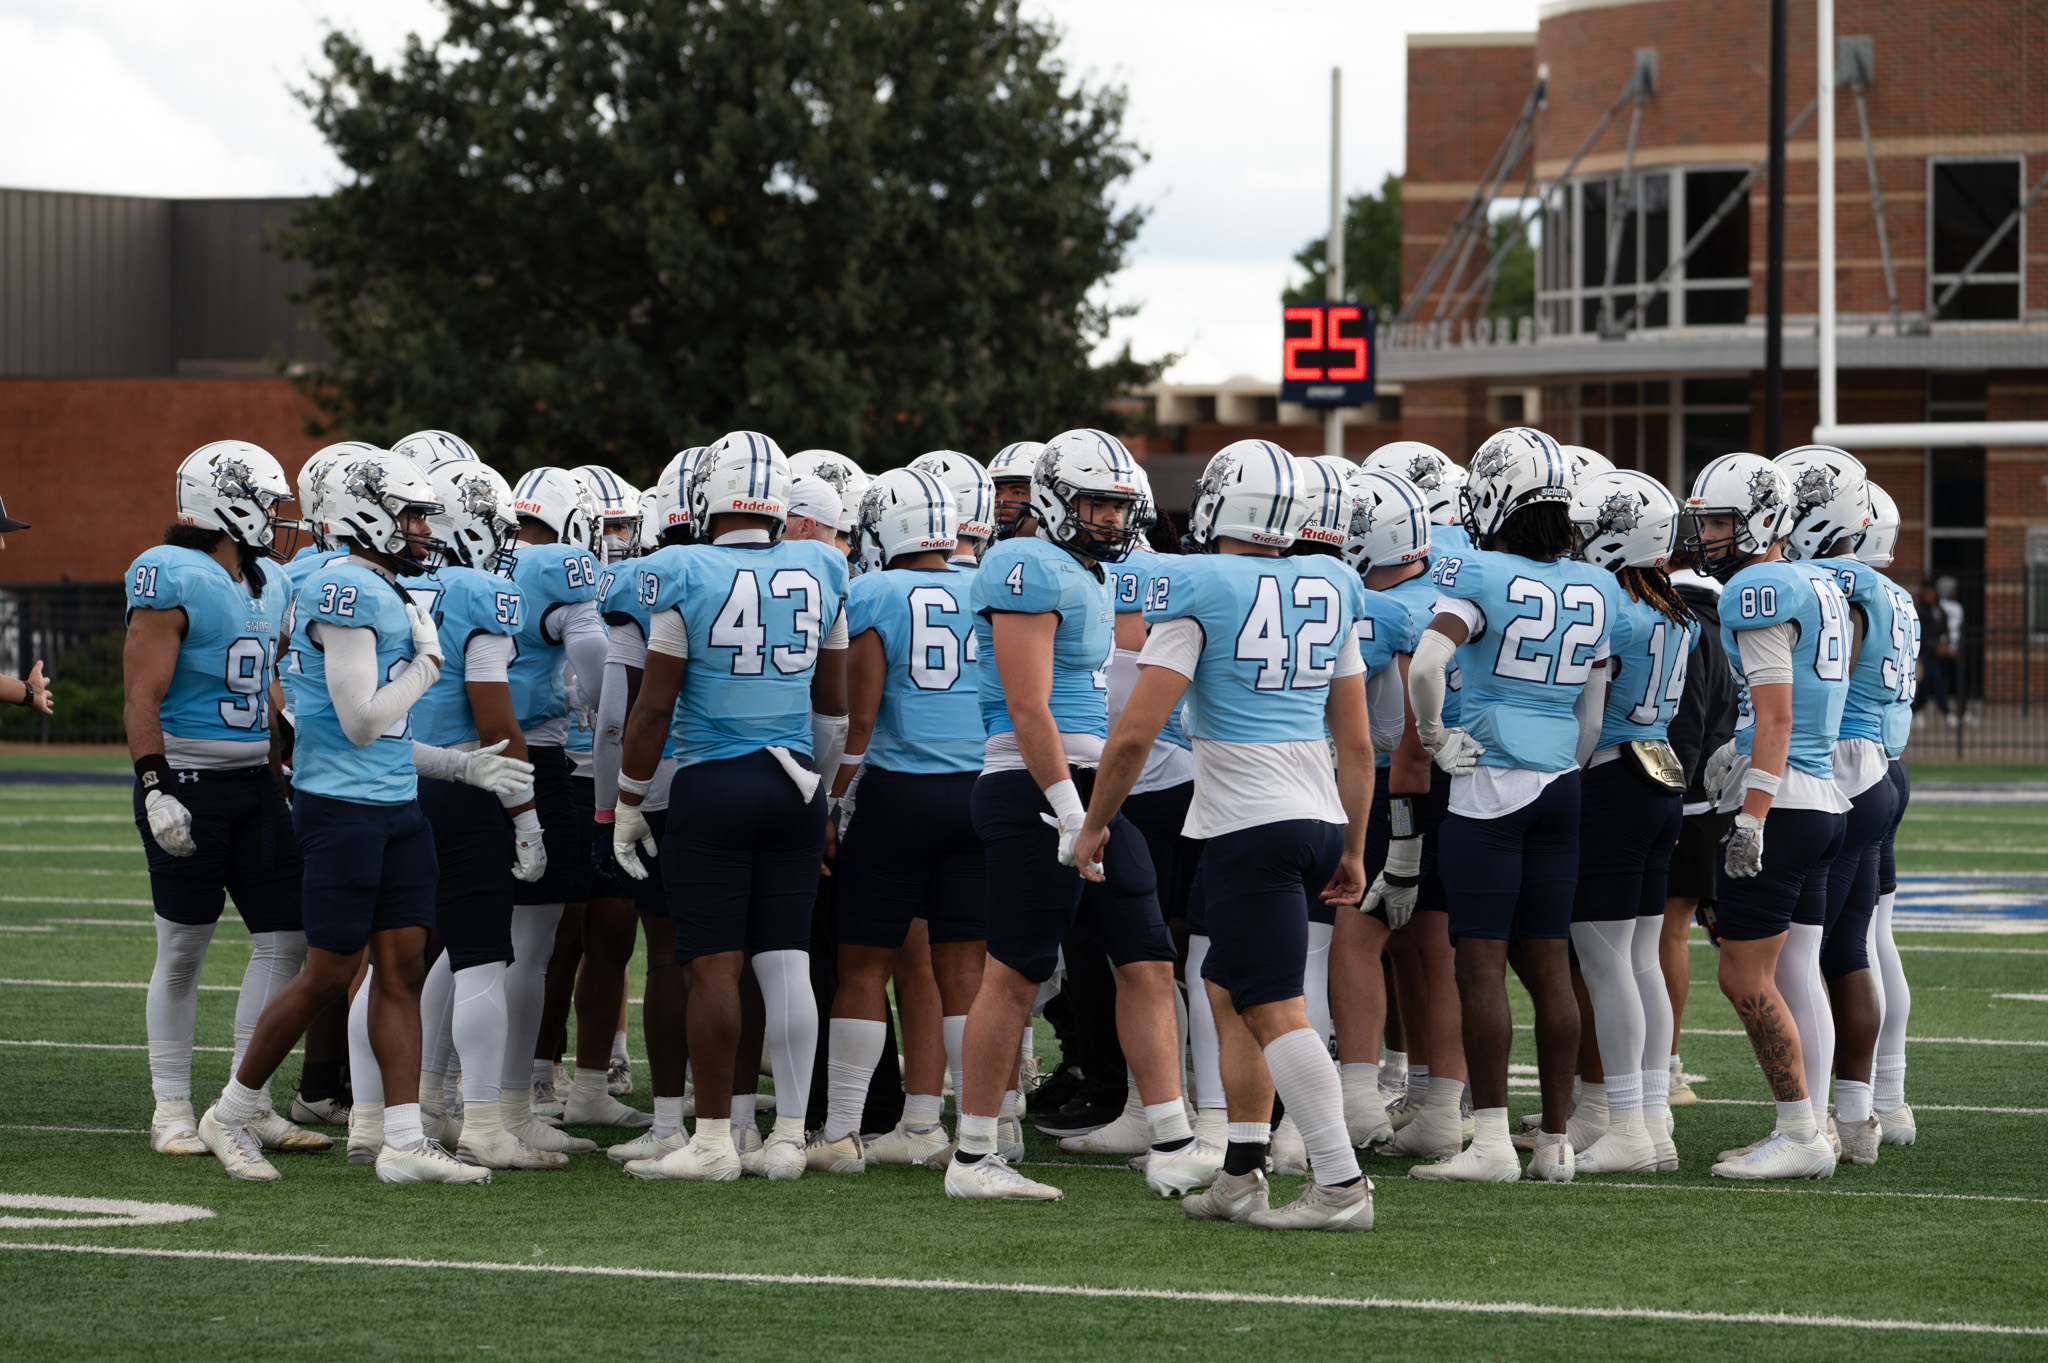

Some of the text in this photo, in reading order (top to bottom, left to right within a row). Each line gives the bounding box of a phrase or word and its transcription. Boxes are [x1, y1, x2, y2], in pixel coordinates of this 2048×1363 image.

[1283, 307, 1368, 381] 25
[668, 510, 690, 525] Rid
[732, 500, 780, 513] Riddell
[920, 539, 955, 549] Riddell
[1252, 532, 1290, 546] Riddell
[1302, 527, 1345, 545] Riddell
[133, 565, 159, 599] 91
[563, 555, 595, 589] 28
[638, 571, 660, 606] 43
[1006, 562, 1024, 596] 4
[1431, 556, 1462, 587] 22
[318, 582, 359, 618] 32
[495, 591, 520, 626] 57
[1145, 577, 1170, 612] 42
[1740, 586, 1777, 619] 80
[708, 568, 822, 676] 43
[1234, 574, 1342, 691] 42
[1492, 575, 1606, 685] 22
[1626, 621, 1691, 726] 14
